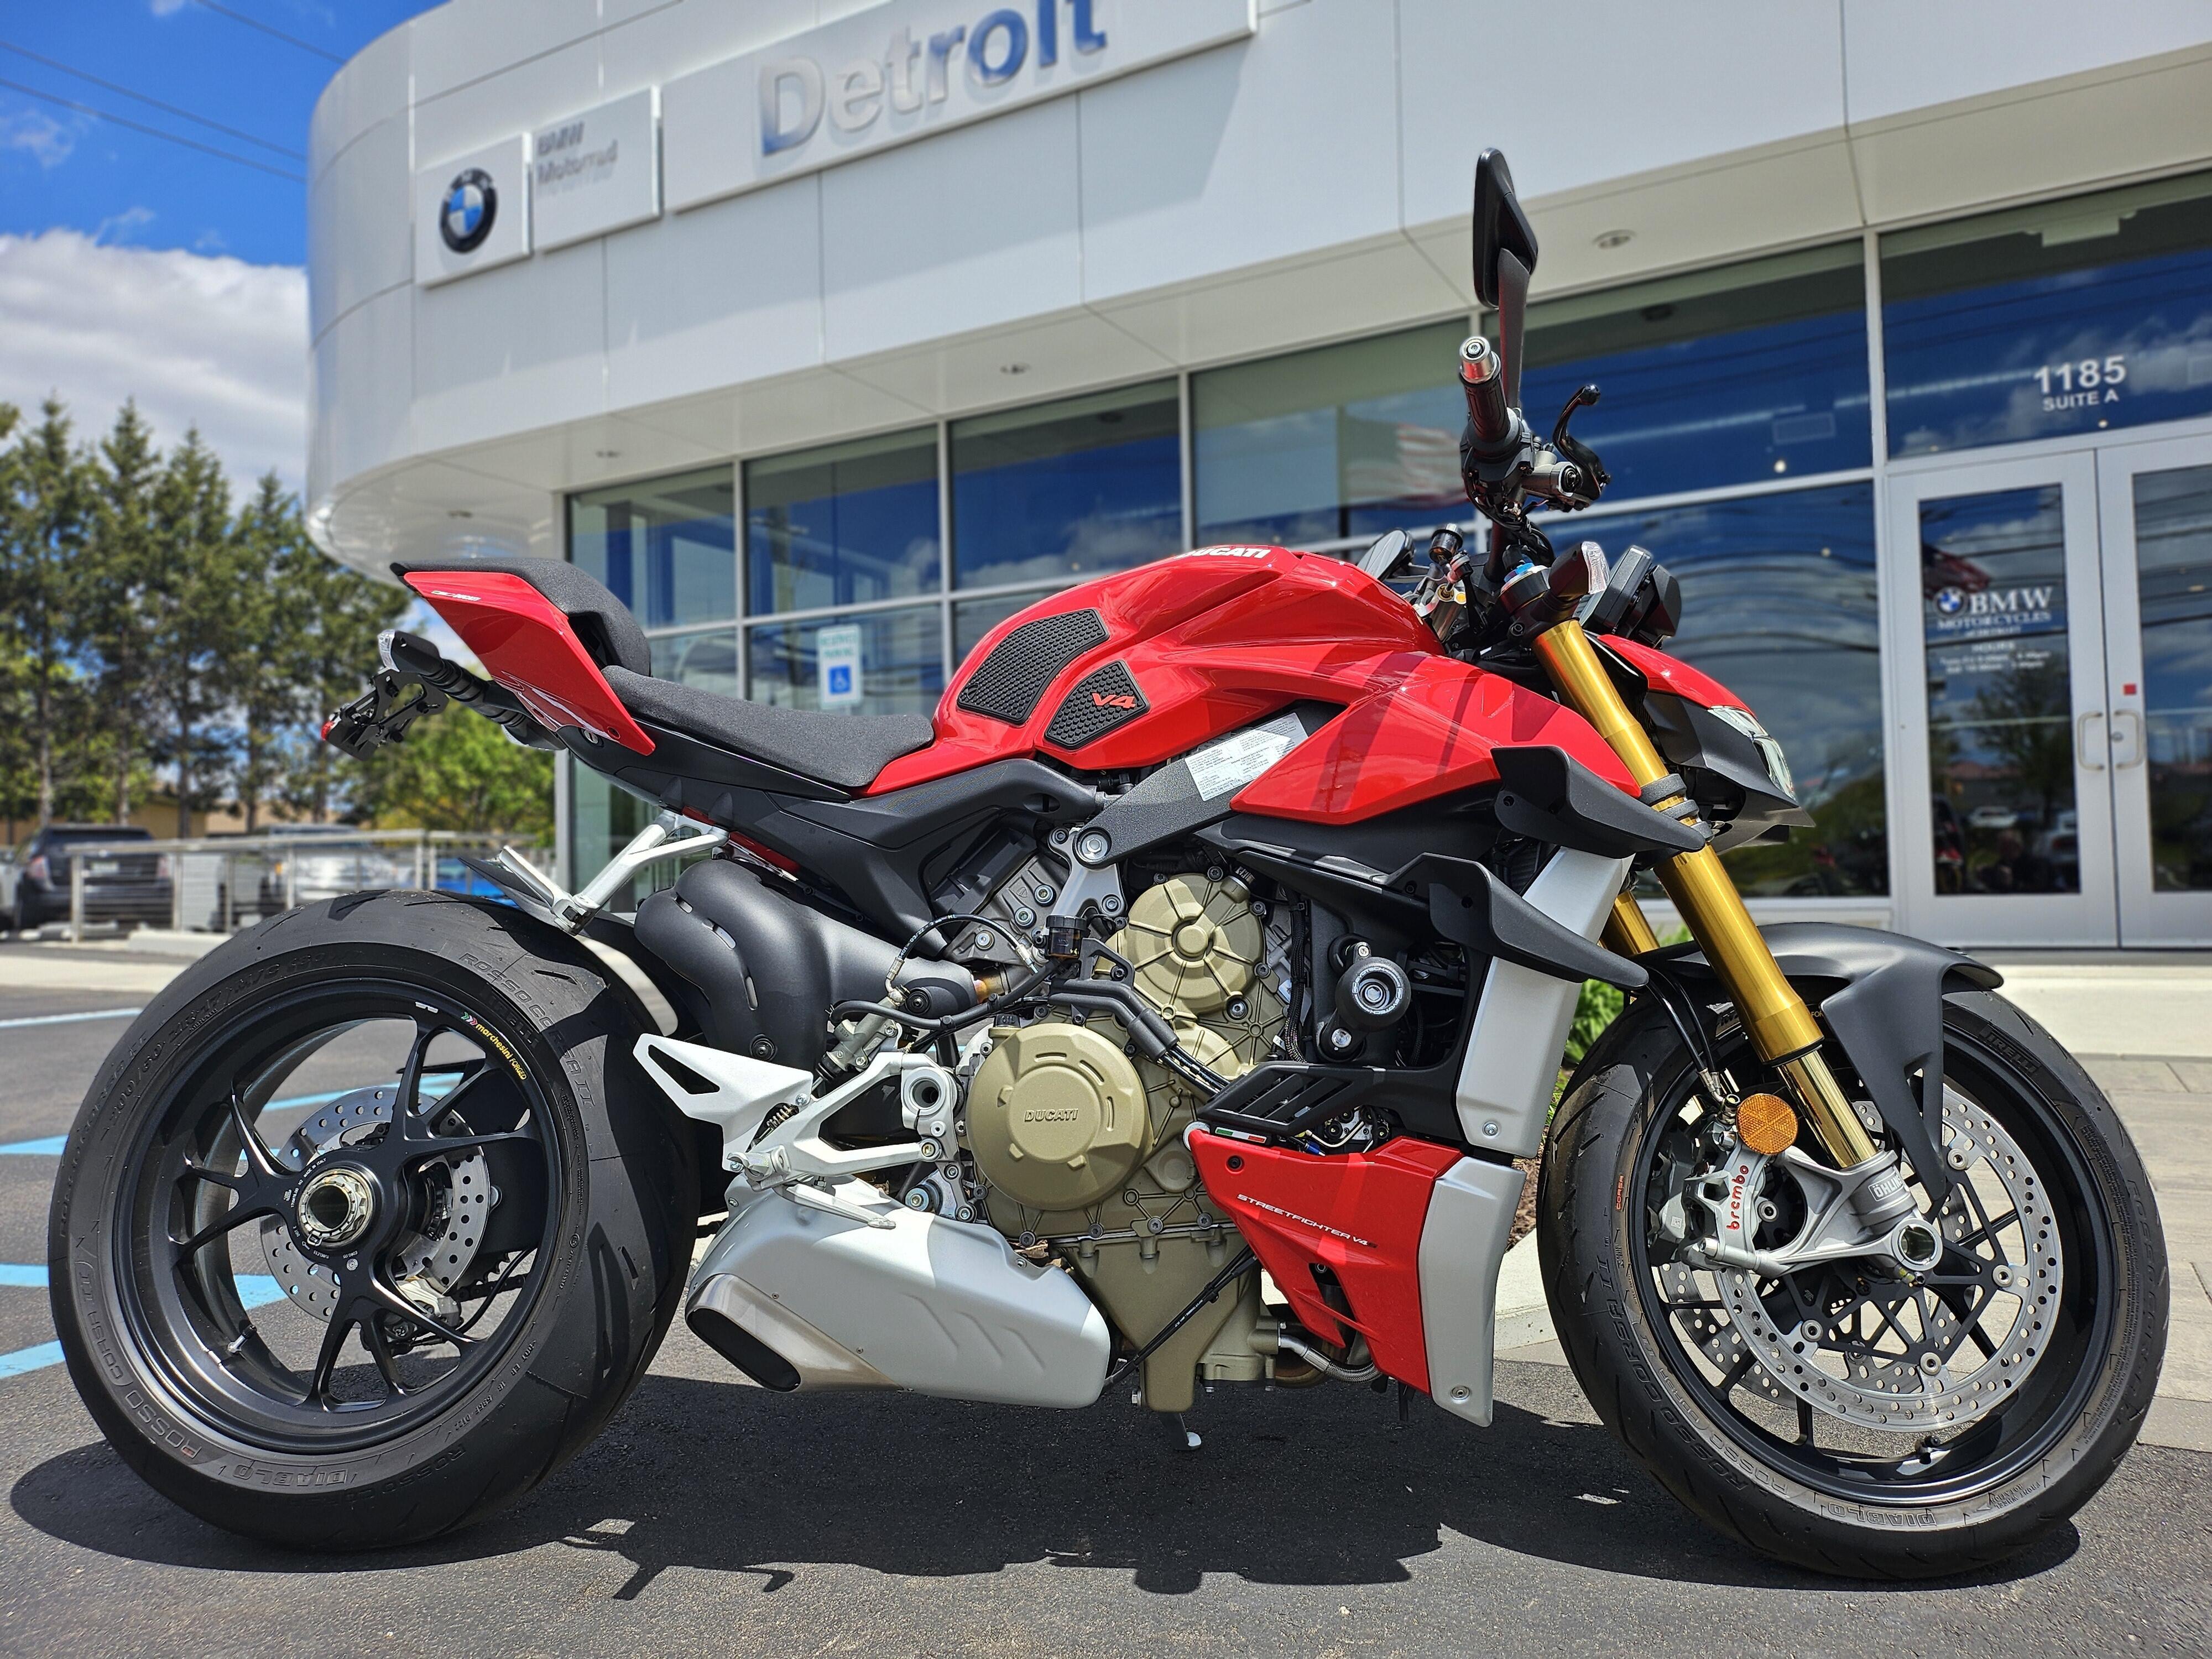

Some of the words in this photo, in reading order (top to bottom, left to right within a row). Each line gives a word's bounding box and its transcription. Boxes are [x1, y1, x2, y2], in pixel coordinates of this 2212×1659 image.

[759, 0, 1108, 157] Detroit
[537, 121, 585, 157] BMW
[538, 139, 618, 185] Motorrad
[2033, 356, 2126, 394] 1185
[2042, 390, 2099, 412] SUITE
[2104, 388, 2119, 404] A
[1970, 586, 2052, 614] BMW
[1937, 611, 2052, 630] MOTORCYCLES
[1092, 693, 1135, 708] V4
[458, 952, 533, 1005] ROSSO
[526, 1003, 582, 1077] CORSA
[1001, 1015, 1015, 1024] OIL
[476, 1024, 513, 1059] marchesini
[509, 1057, 527, 1080] FORGED
[1024, 1108, 1079, 1123] DUCATI
[1615, 1175, 1625, 1211] CORSA
[1726, 1165, 1749, 1230] brembo
[1237, 1193, 1352, 1240] STREETFIGHTER
[1597, 1255, 1615, 1293] II
[87, 1309, 125, 1383] CORSA
[1605, 1298, 1662, 1404] CORSA
[1658, 1368, 1700, 1423] CORSA
[126, 1390, 203, 1460] ROSSO
[1660, 1405, 1749, 1491] ROSSO
[1709, 1431, 1788, 1494] ROSSO
[232, 1463, 349, 1487] DIABLO
[2020, 1481, 2041, 1498] FRONT
[1828, 1503, 1937, 1528] DIABLO
